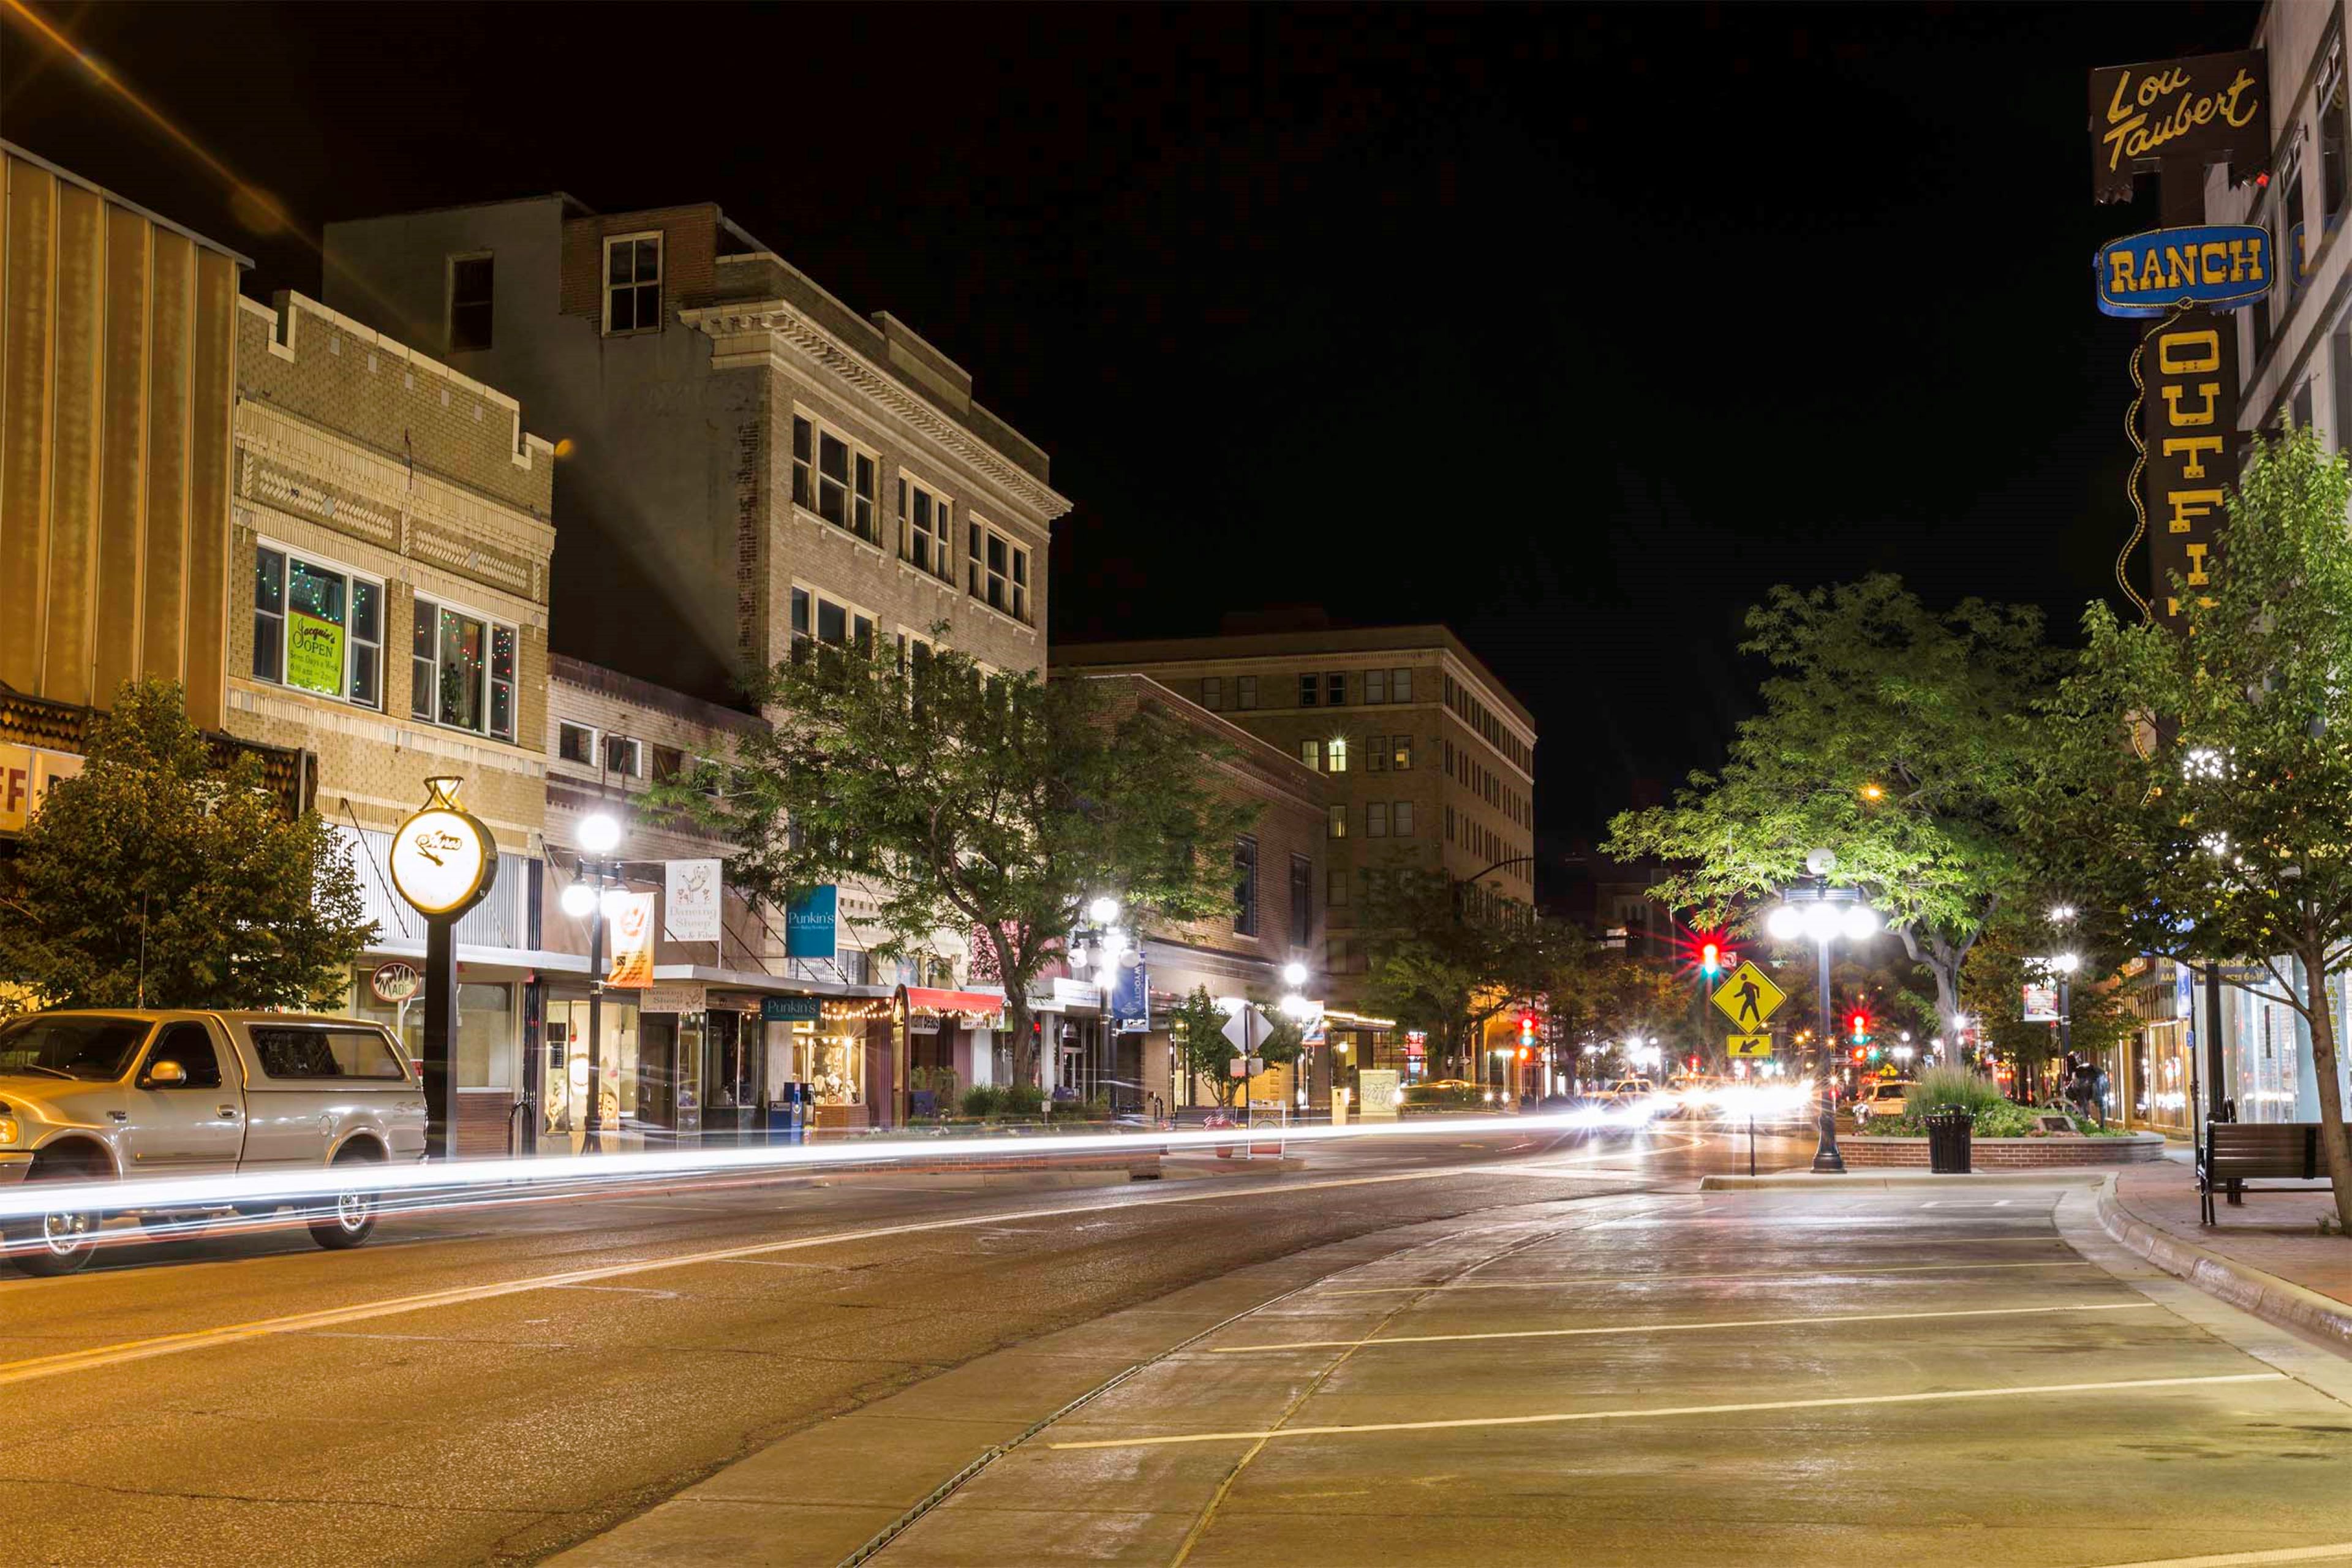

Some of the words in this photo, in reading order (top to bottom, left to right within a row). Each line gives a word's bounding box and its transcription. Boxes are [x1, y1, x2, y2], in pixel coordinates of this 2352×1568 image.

[2107, 66, 2192, 124] Lou
[2102, 68, 2259, 172] Taubert
[2109, 238, 2264, 293] RANCH
[304, 639, 333, 658] OPEN
[676, 919, 711, 930] Sheep
[788, 911, 835, 924] Punkin's
[767, 1000, 816, 1014] Punkin's
